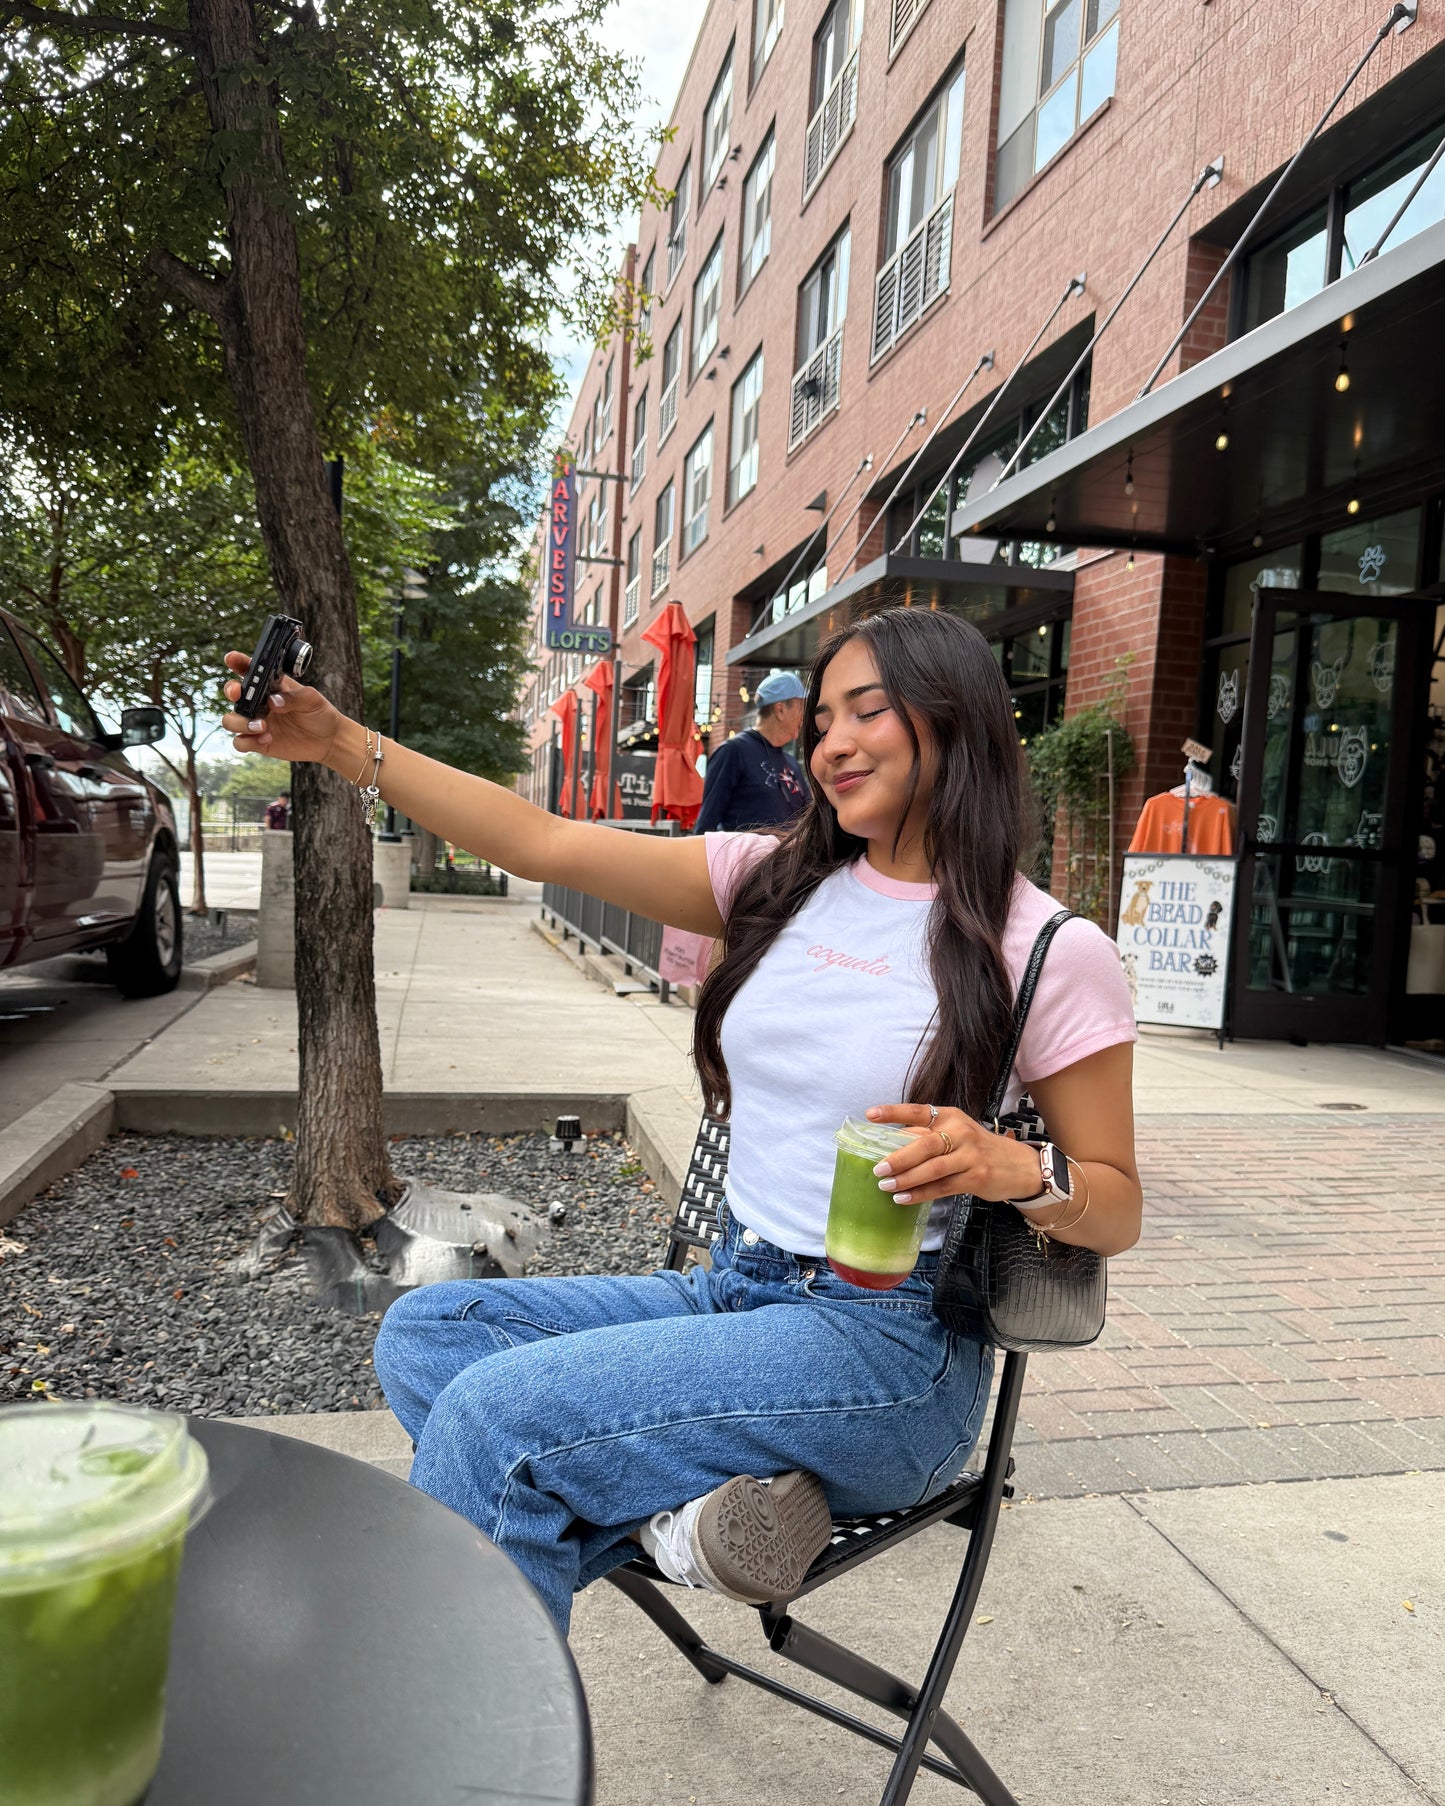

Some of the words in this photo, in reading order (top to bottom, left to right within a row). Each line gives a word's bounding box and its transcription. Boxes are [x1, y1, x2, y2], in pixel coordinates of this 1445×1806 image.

[550, 630, 609, 651] LOFTS
[1159, 881, 1196, 902] THE
[1147, 903, 1203, 925] BEAD
[1133, 926, 1213, 950] COLLAR
[1149, 950, 1192, 973] BAR
